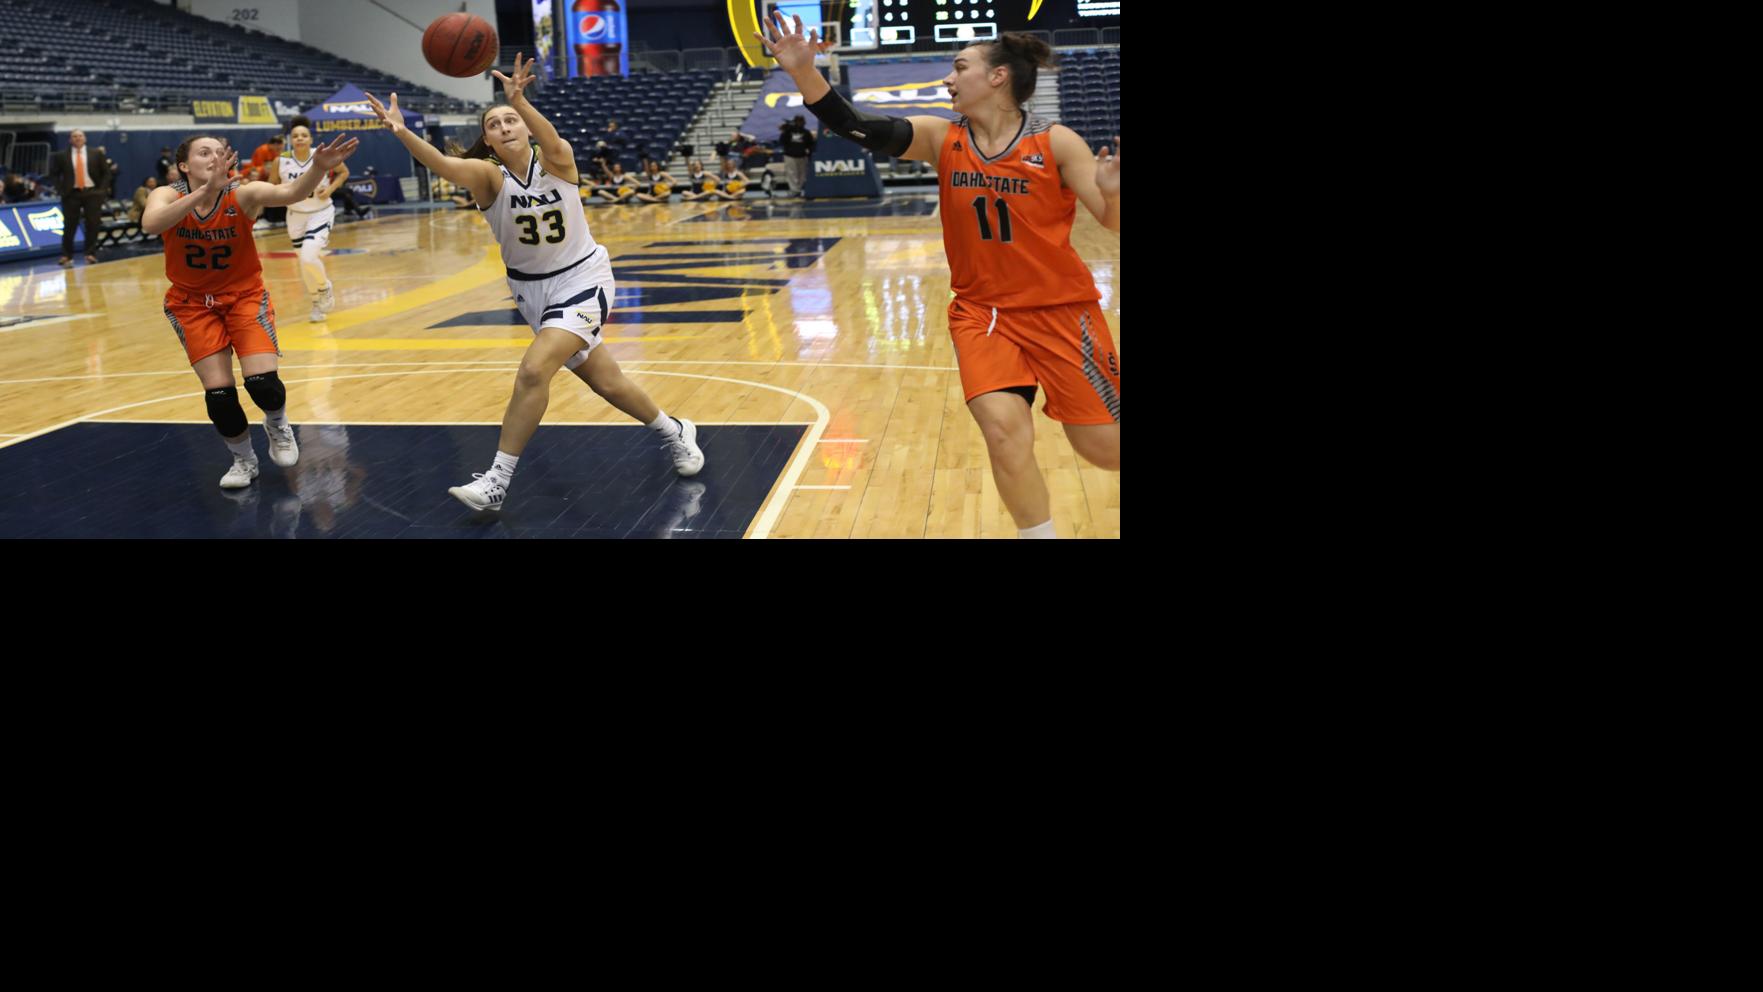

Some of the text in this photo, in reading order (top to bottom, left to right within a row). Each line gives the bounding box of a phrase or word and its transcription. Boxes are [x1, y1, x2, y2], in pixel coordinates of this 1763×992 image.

[232, 8, 259, 21] 202
[316, 119, 386, 132] LUMBERJAC
[814, 159, 866, 173] NAU
[510, 189, 562, 209] NAU
[515, 209, 566, 246] 33
[972, 195, 1012, 243] 11
[184, 244, 233, 270] 22
[576, 312, 593, 324] NAU
